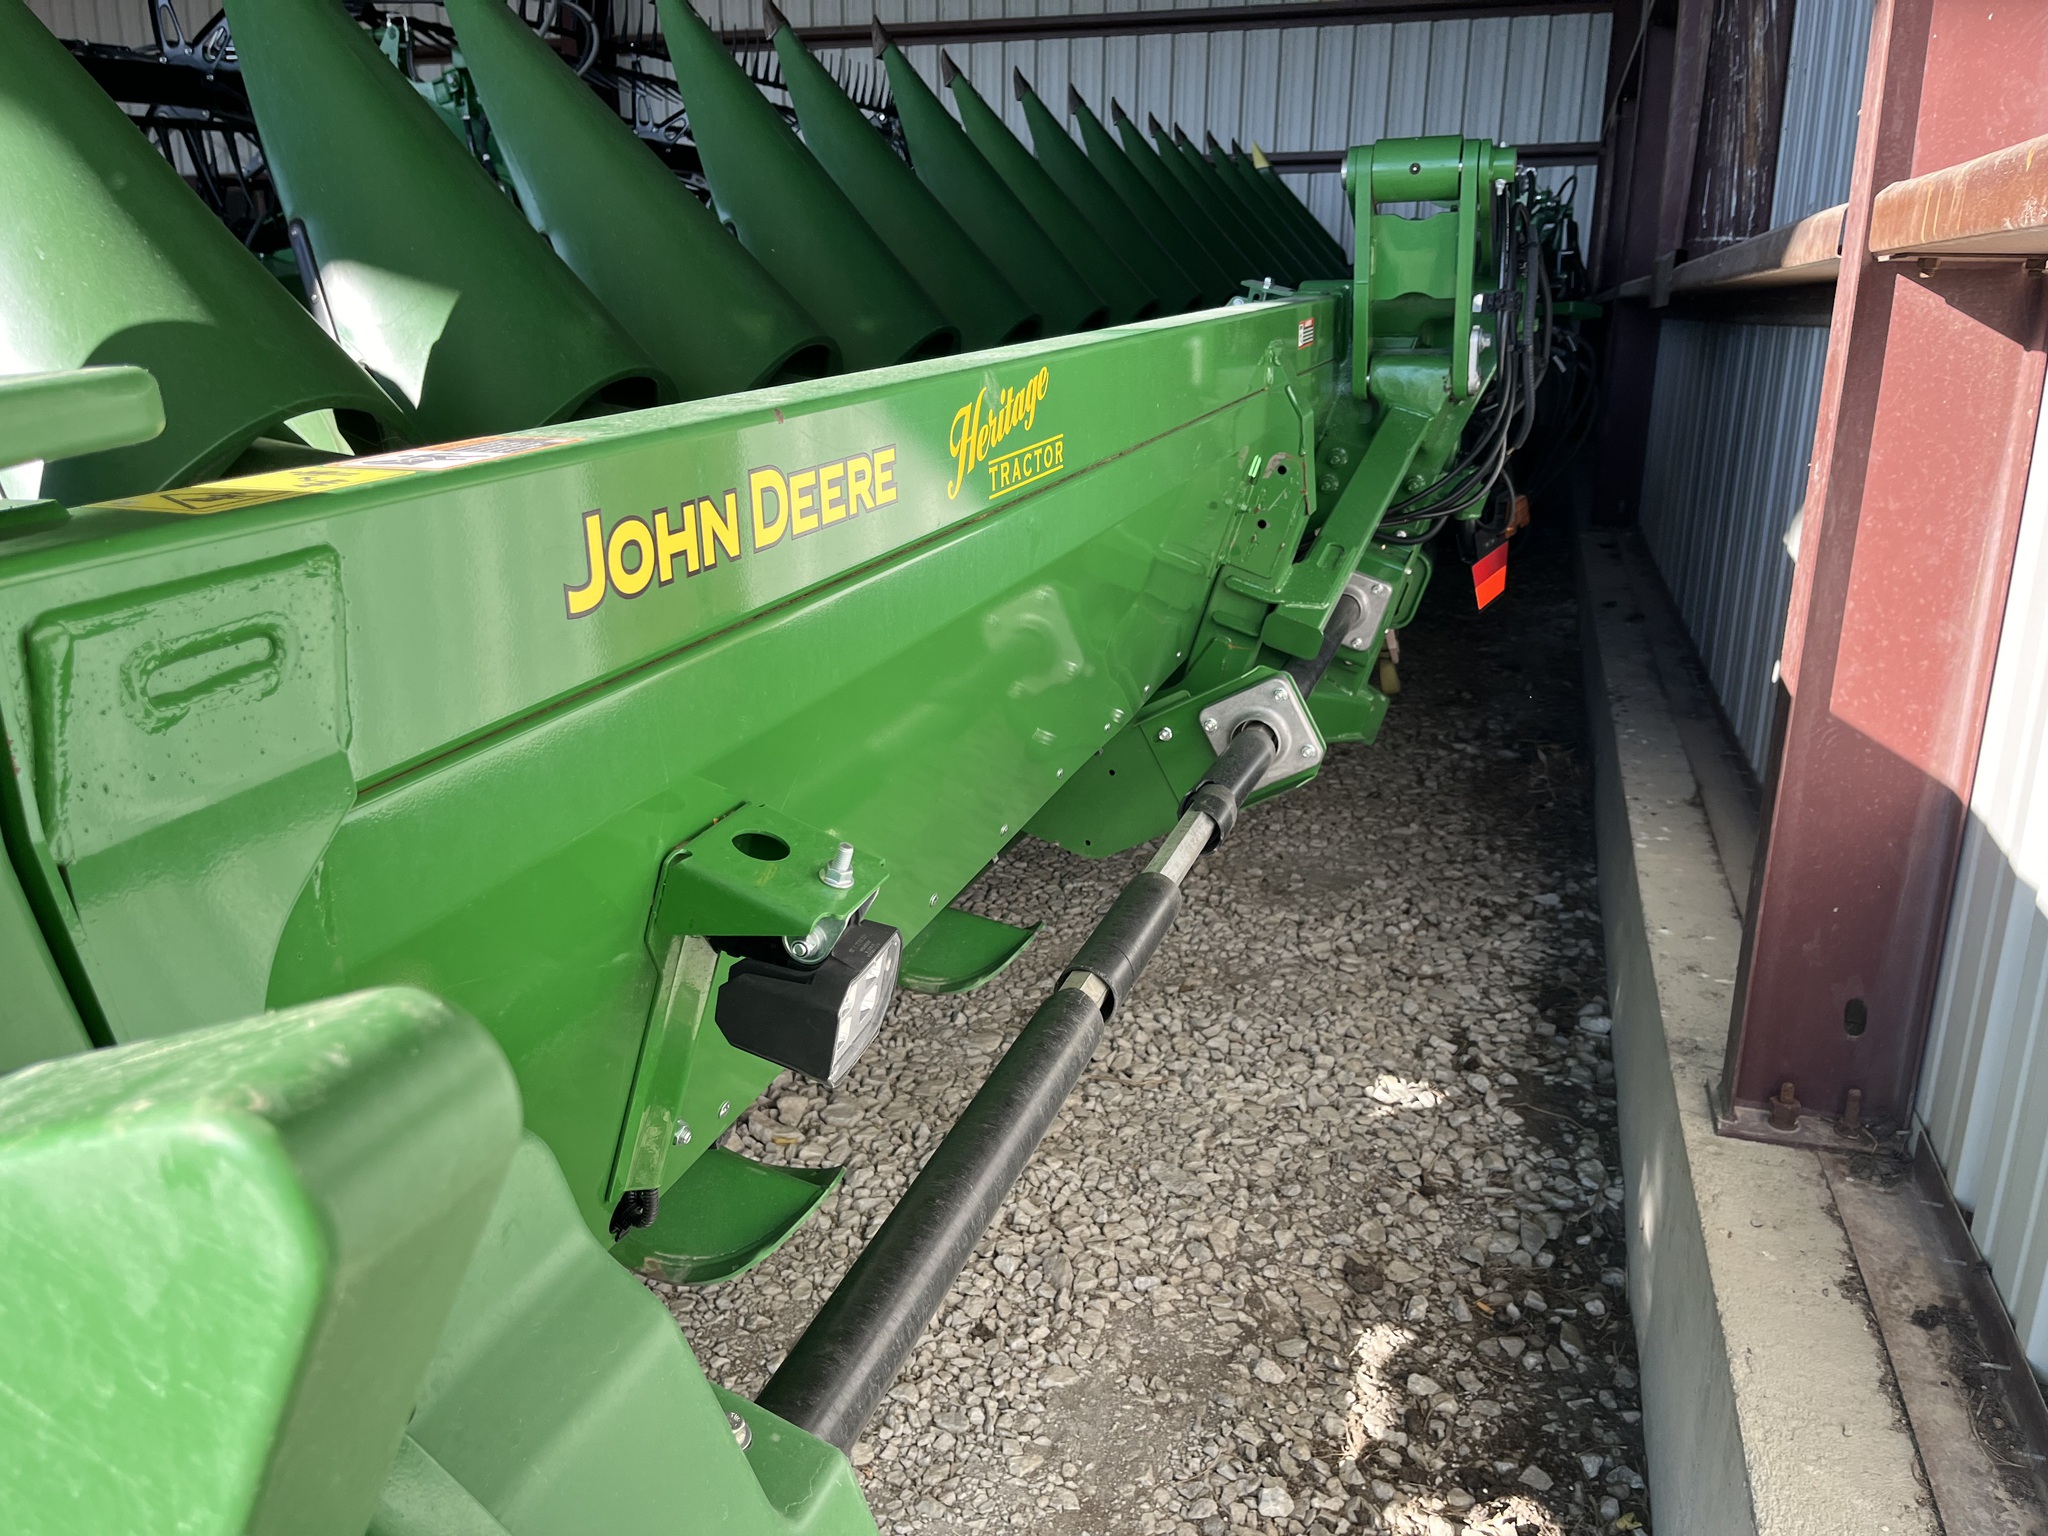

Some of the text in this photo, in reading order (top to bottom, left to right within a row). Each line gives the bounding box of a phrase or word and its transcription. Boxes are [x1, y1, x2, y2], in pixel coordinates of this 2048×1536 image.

[947, 366, 1049, 500] Heritage
[988, 440, 1064, 492] TRACTOR
[563, 443, 899, 620] JOHN DEERE
